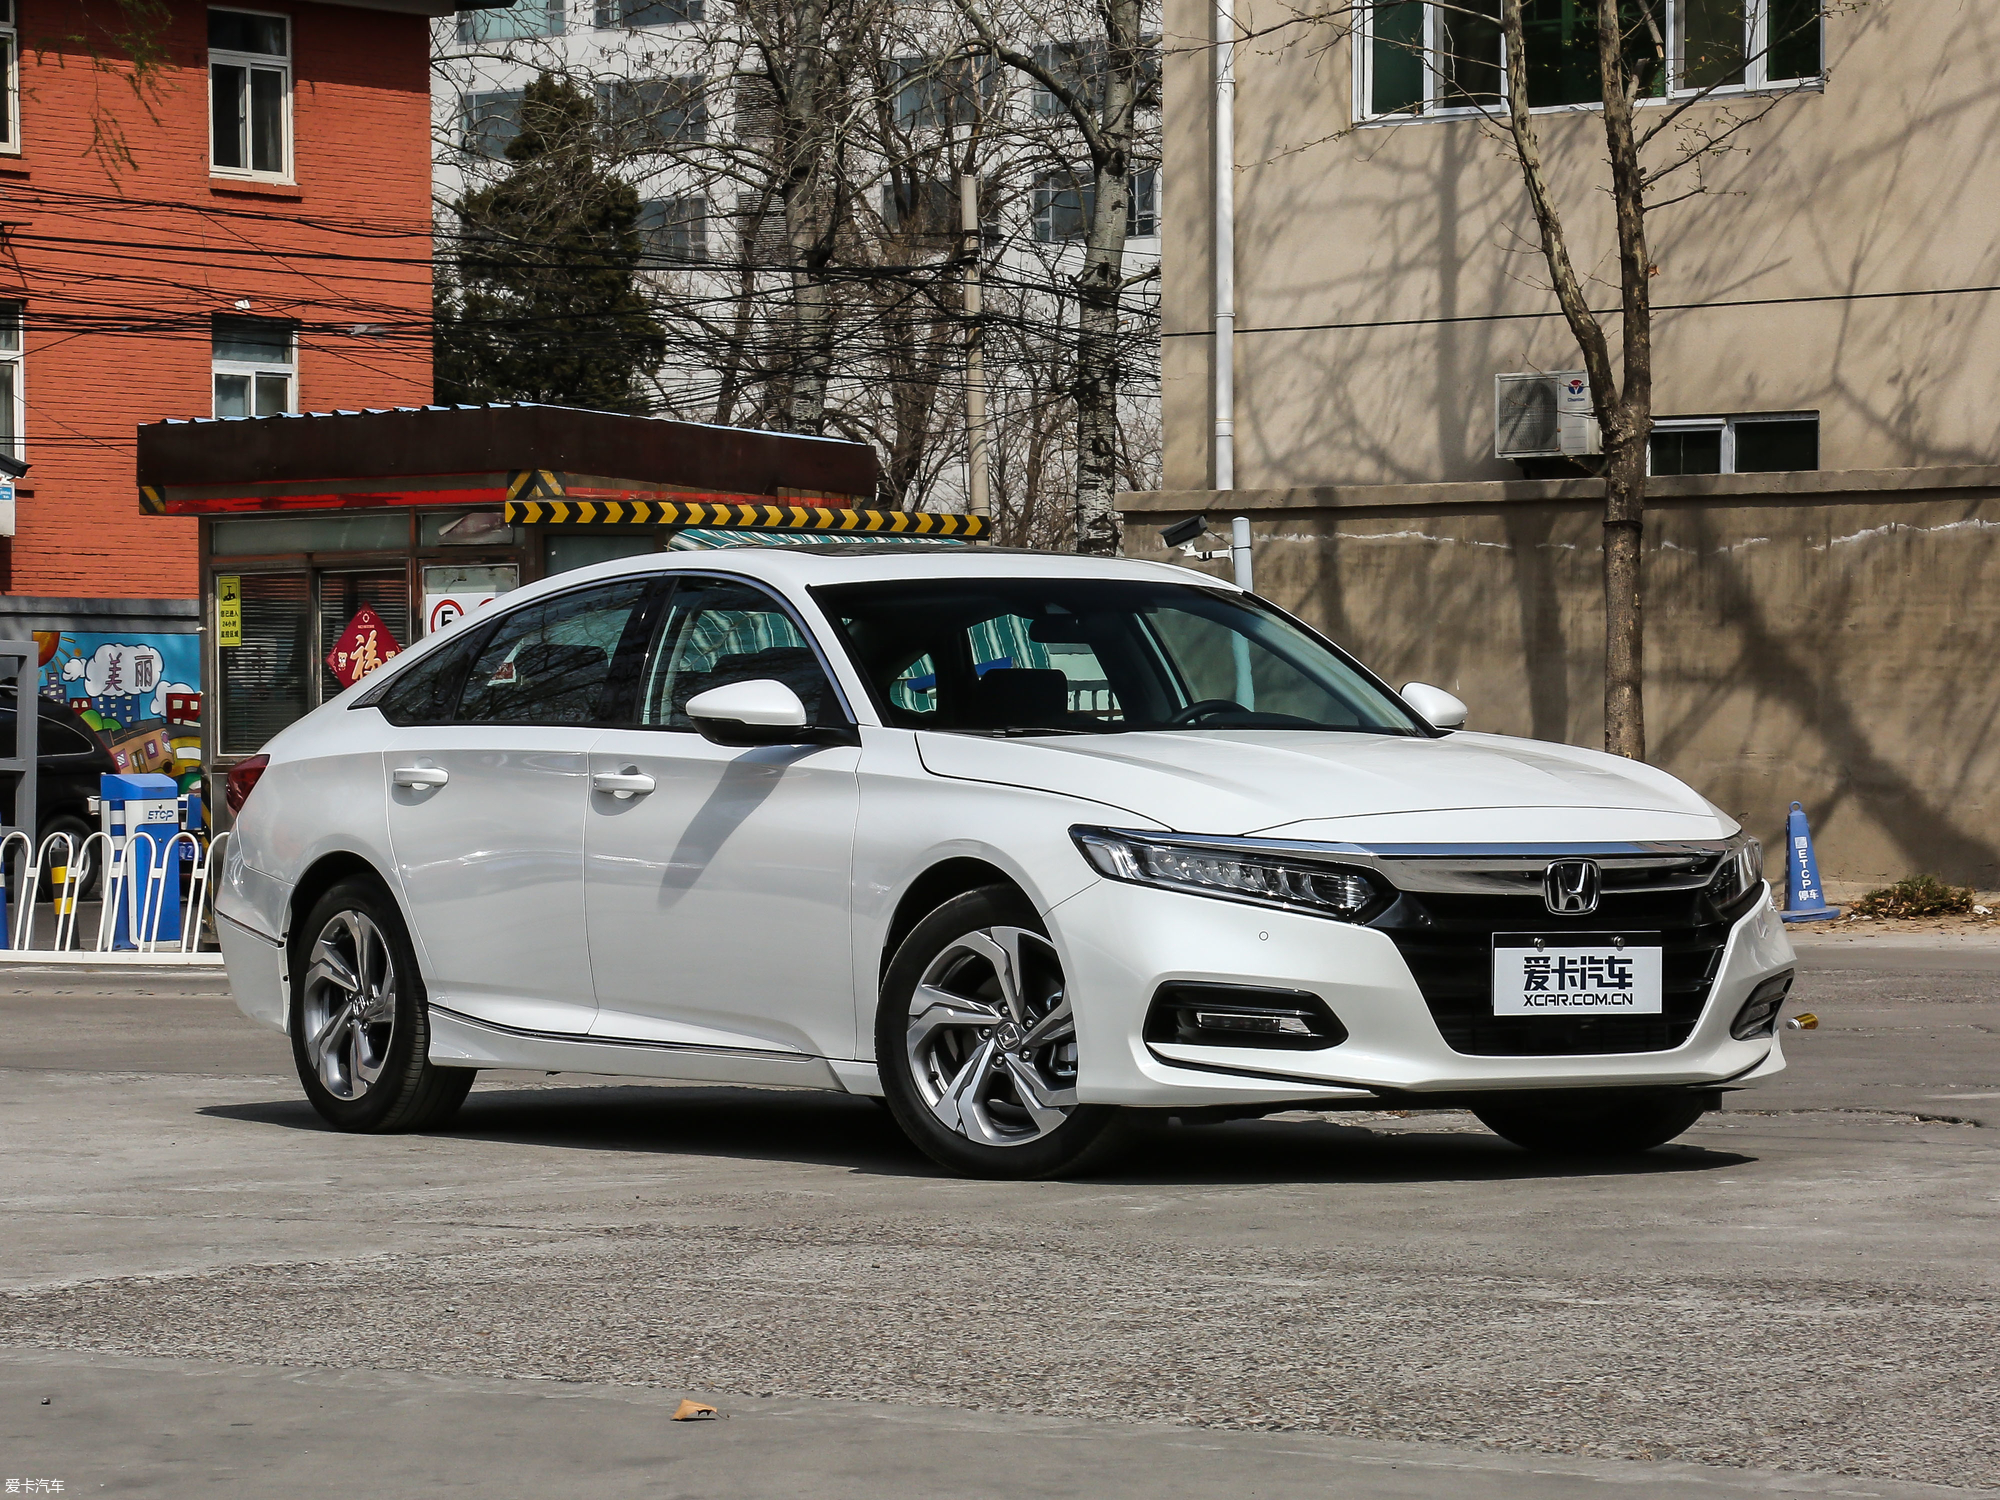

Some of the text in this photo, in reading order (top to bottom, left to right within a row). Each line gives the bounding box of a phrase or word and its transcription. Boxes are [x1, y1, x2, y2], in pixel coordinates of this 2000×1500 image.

[103, 652, 154, 691] 美丽
[148, 810, 174, 821] ETCP
[1798, 849, 1812, 890] ETCP
[1523, 956, 1633, 991] 爱卡汽车
[1523, 993, 1633, 1007] XCAR.COM.CN
